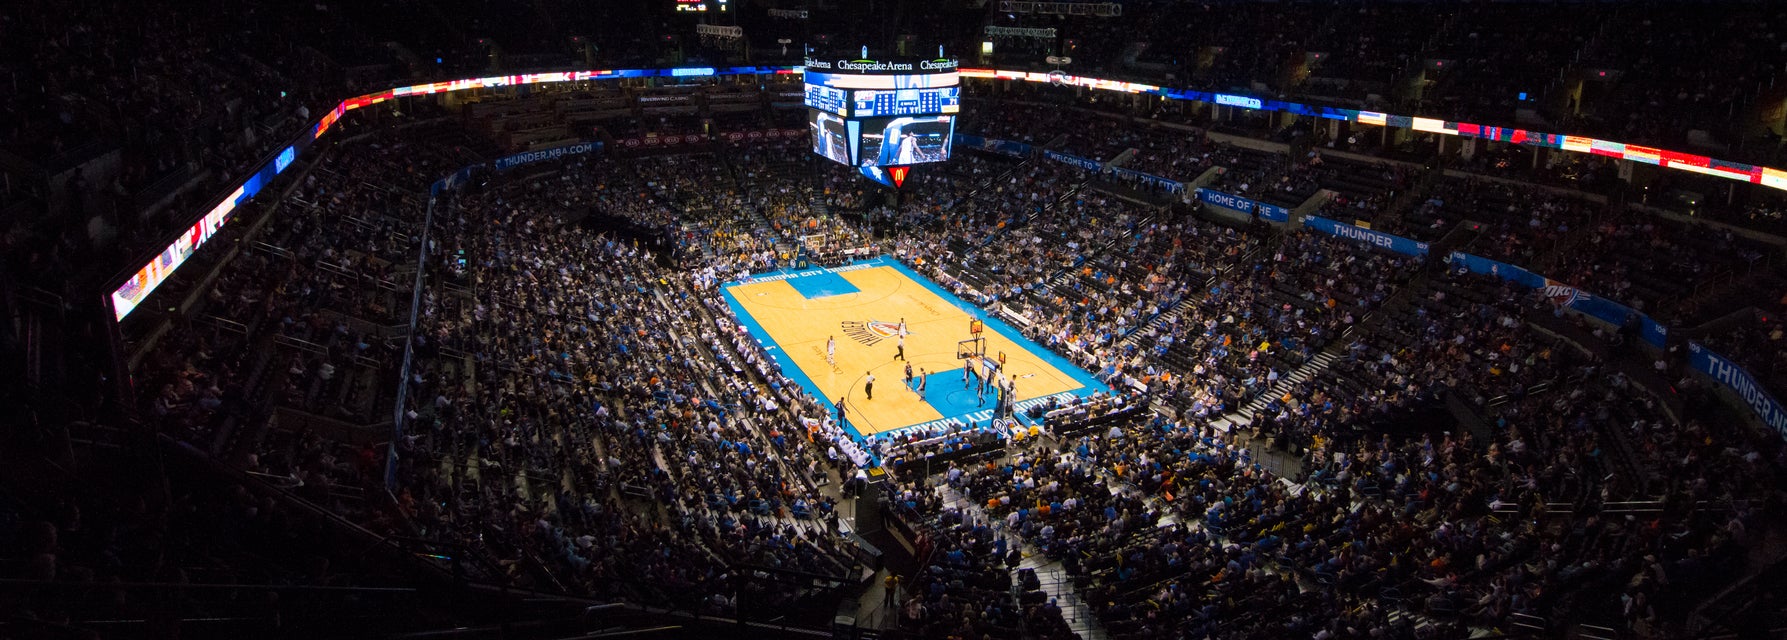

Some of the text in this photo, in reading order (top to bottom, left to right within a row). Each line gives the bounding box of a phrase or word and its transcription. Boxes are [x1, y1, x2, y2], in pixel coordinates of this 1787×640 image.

[838, 60, 912, 73] Chesapeake Arena
[504, 144, 592, 167] THUNDER.NBA.COM
[1050, 153, 1093, 170] WELCOME TO
[1208, 192, 1272, 216] HOME OF HE
[1334, 224, 1393, 248] THUNDER
[800, 269, 823, 277] CITY
[1544, 286, 1571, 297] OKC
